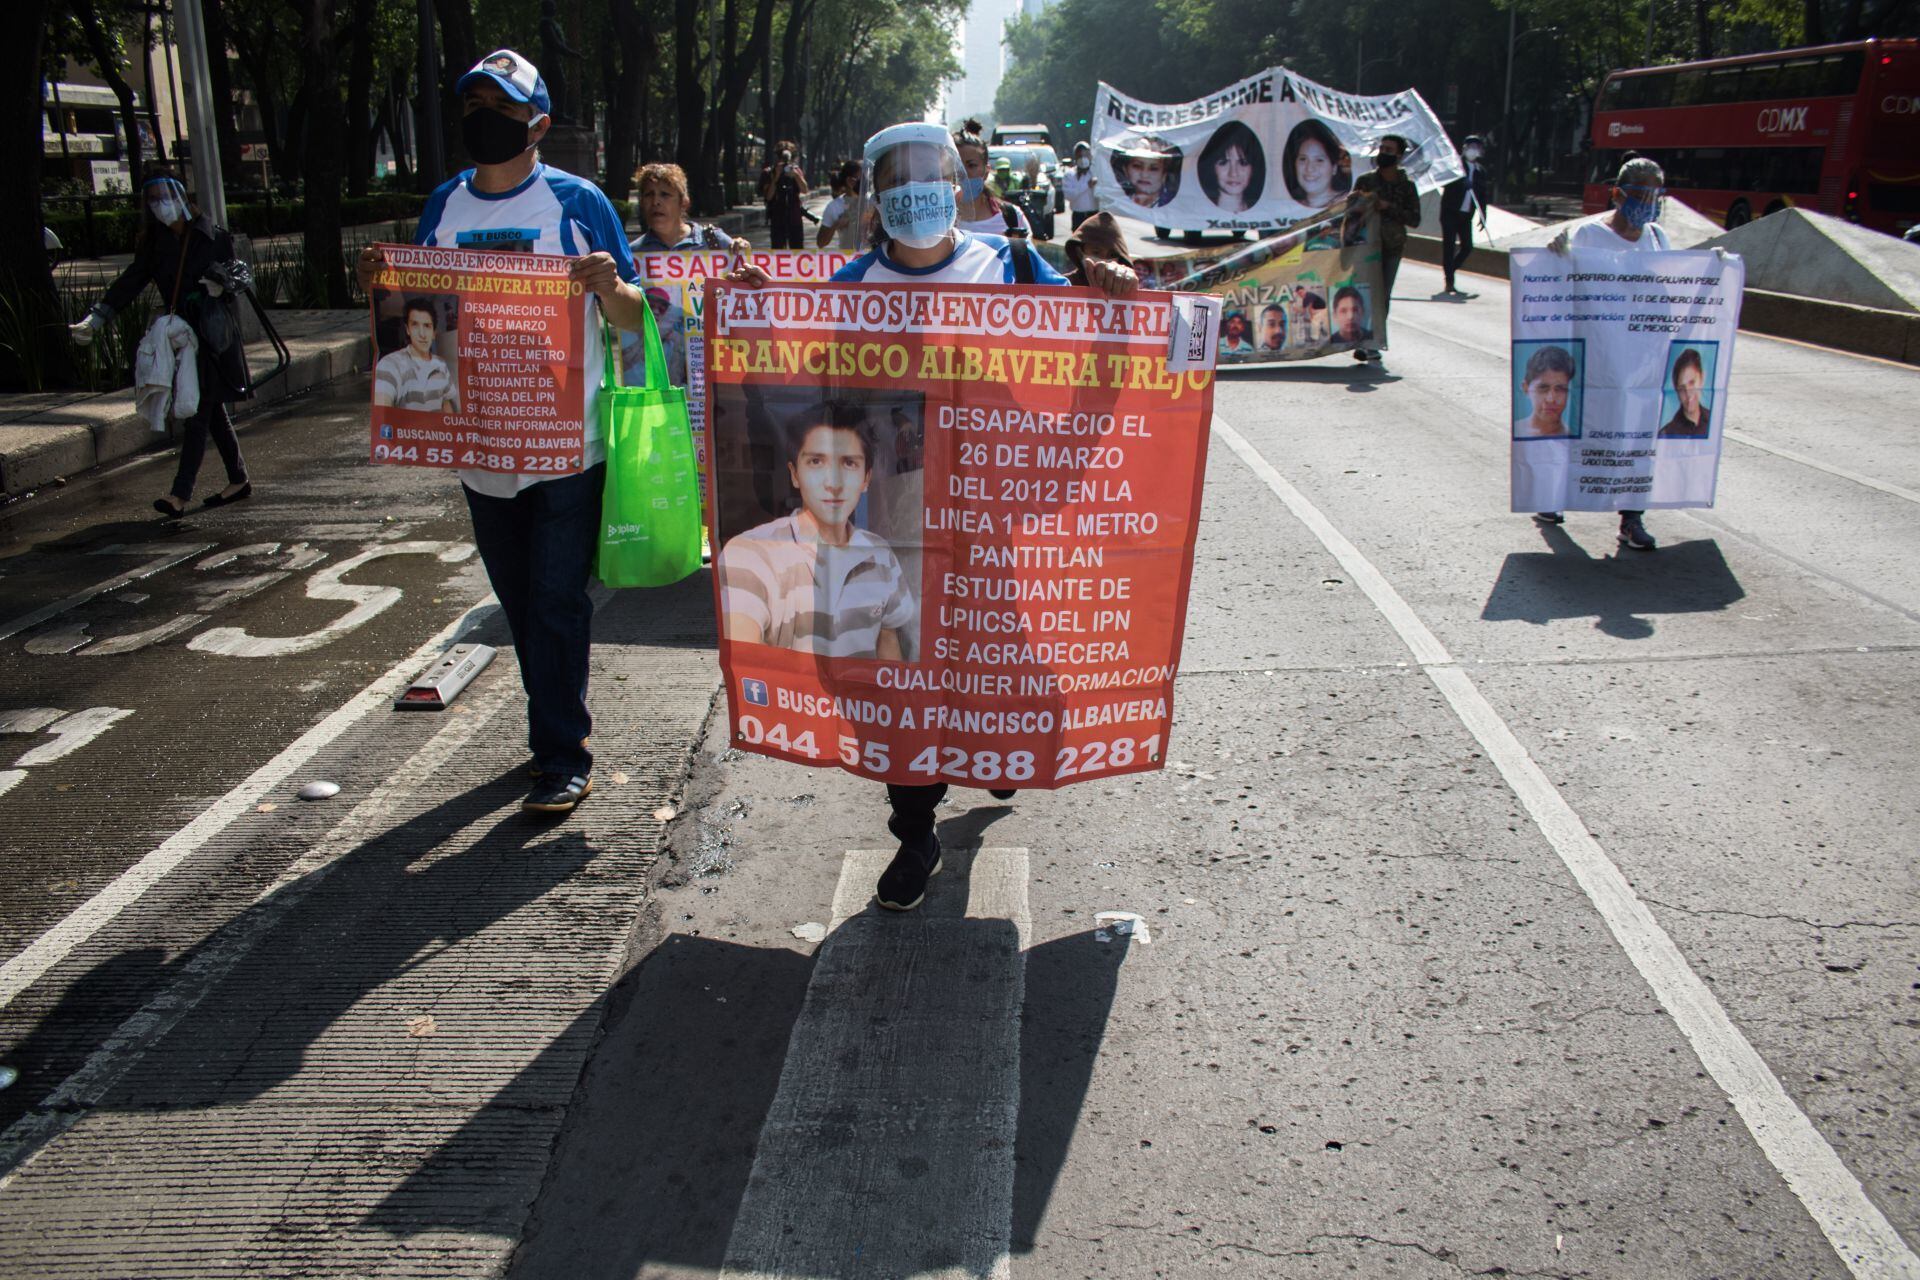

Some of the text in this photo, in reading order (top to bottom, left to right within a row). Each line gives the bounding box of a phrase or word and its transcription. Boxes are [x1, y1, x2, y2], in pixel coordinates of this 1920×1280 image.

[1281, 76, 1296, 103] A
[1757, 106, 1809, 133] CDMX
[1205, 217, 1301, 230] Xalapa Ve
[472, 231, 523, 242] TE BUSCO
[383, 249, 451, 268] YUDANOS
[453, 253, 465, 267] A
[632, 252, 866, 280] ESAPARECID
[372, 269, 583, 299] FRANCISCO ALBAVERA TREJO
[1617, 274, 1654, 283] ADRIAN
[1695, 276, 1721, 286] PEREZ
[1222, 286, 1296, 307] ANZA
[1522, 294, 1549, 303] Fecha
[1551, 294, 1563, 303] de
[1632, 294, 1643, 303] 16
[1647, 295, 1657, 303] DE
[1660, 295, 1692, 304] ENERO
[1694, 297, 1707, 305] DEL
[465, 302, 558, 317] DESAPARECIO EL
[720, 292, 901, 329] ¡AYUDANOS
[909, 297, 934, 327] A
[946, 296, 1168, 336] ENCONTRARL
[1551, 313, 1562, 322] de
[474, 319, 547, 331] 26 DE MARZO
[1628, 323, 1680, 332] DE MEXICO
[469, 332, 552, 346] DEL 2012 EN LA
[458, 347, 565, 361] LINEA 1 DEL METRO
[711, 338, 908, 377] FRANCISCO
[918, 345, 1100, 387] ALBAVERA
[478, 363, 540, 373] PANTITLAN
[467, 376, 554, 388] ESTUDIANTE DE
[468, 390, 555, 402] UPIICSA DEL IPN
[467, 403, 557, 417] SE AGRADECERA
[939, 406, 1152, 437] DESAPARECIO EL
[443, 416, 583, 431] CUALQUIER INFORMACION
[397, 428, 581, 449] BUSCANDO A FRANCISCO ALBAVERA
[375, 445, 418, 461] 044
[426, 448, 454, 464] 55
[461, 450, 516, 470] 4288
[959, 443, 1124, 469] 26 DE MARZO
[949, 474, 1132, 503] DEL 2012 EN LA
[925, 507, 1158, 536] LINEA 1 DEL METRO
[969, 544, 1104, 569] PANTITLAN
[944, 573, 1131, 601] ESTUDIANTE DE
[940, 605, 1131, 633] UPIICSA DEL IPN
[934, 637, 1130, 665] SE AGRADECERA
[876, 664, 1177, 696] CUALQUIER INFORMACION
[776, 687, 1168, 735] BUSCANDO A FRANCISCO ALBAVERA
[738, 715, 1161, 781] 044 55 4288 2281
